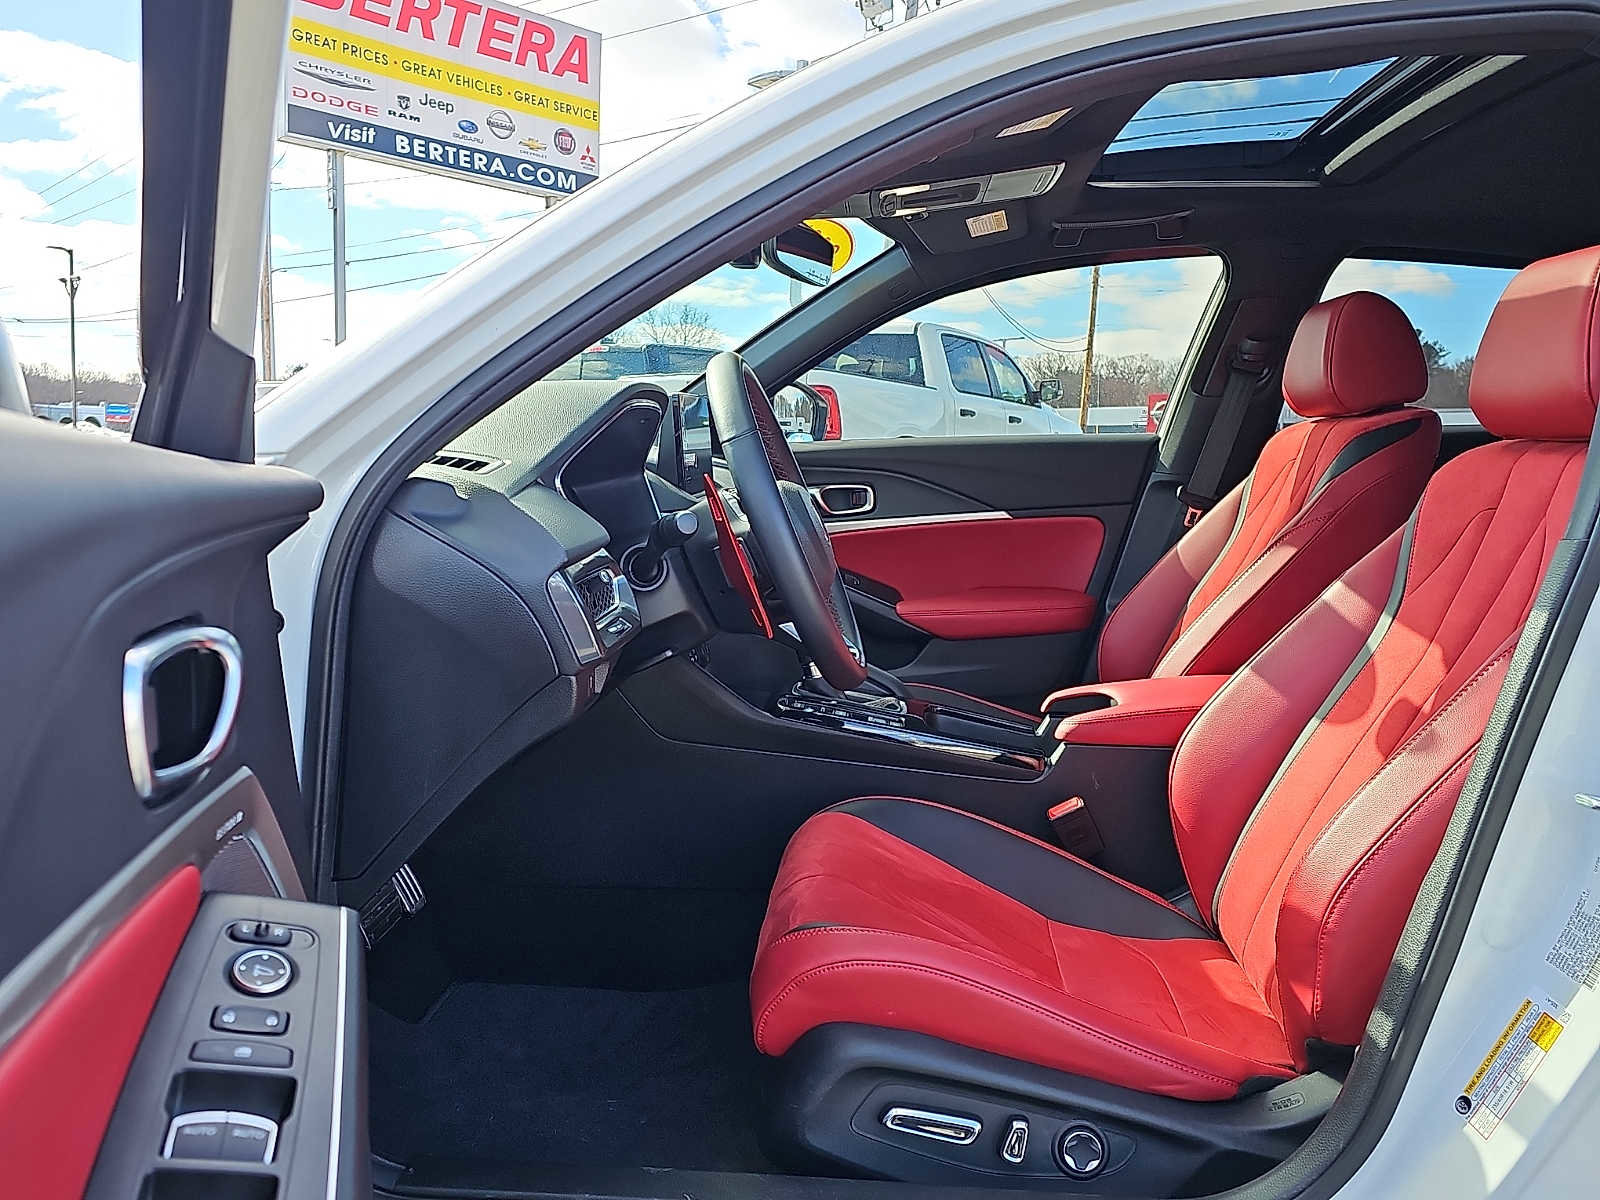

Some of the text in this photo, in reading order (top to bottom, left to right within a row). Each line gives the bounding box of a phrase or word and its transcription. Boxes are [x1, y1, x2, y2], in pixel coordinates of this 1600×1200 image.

[301, 0, 588, 84] RTERA
[292, 28, 598, 122] GREAT PRICES GREAT VEHICLES GREAT SERVICE
[298, 60, 373, 85] CHRYSLER
[292, 86, 379, 117] DODGE
[418, 93, 455, 114] Jeep
[387, 109, 421, 123] RAM
[487, 119, 514, 132] NISSAN
[327, 121, 577, 191] Visit BERTERA.COM
